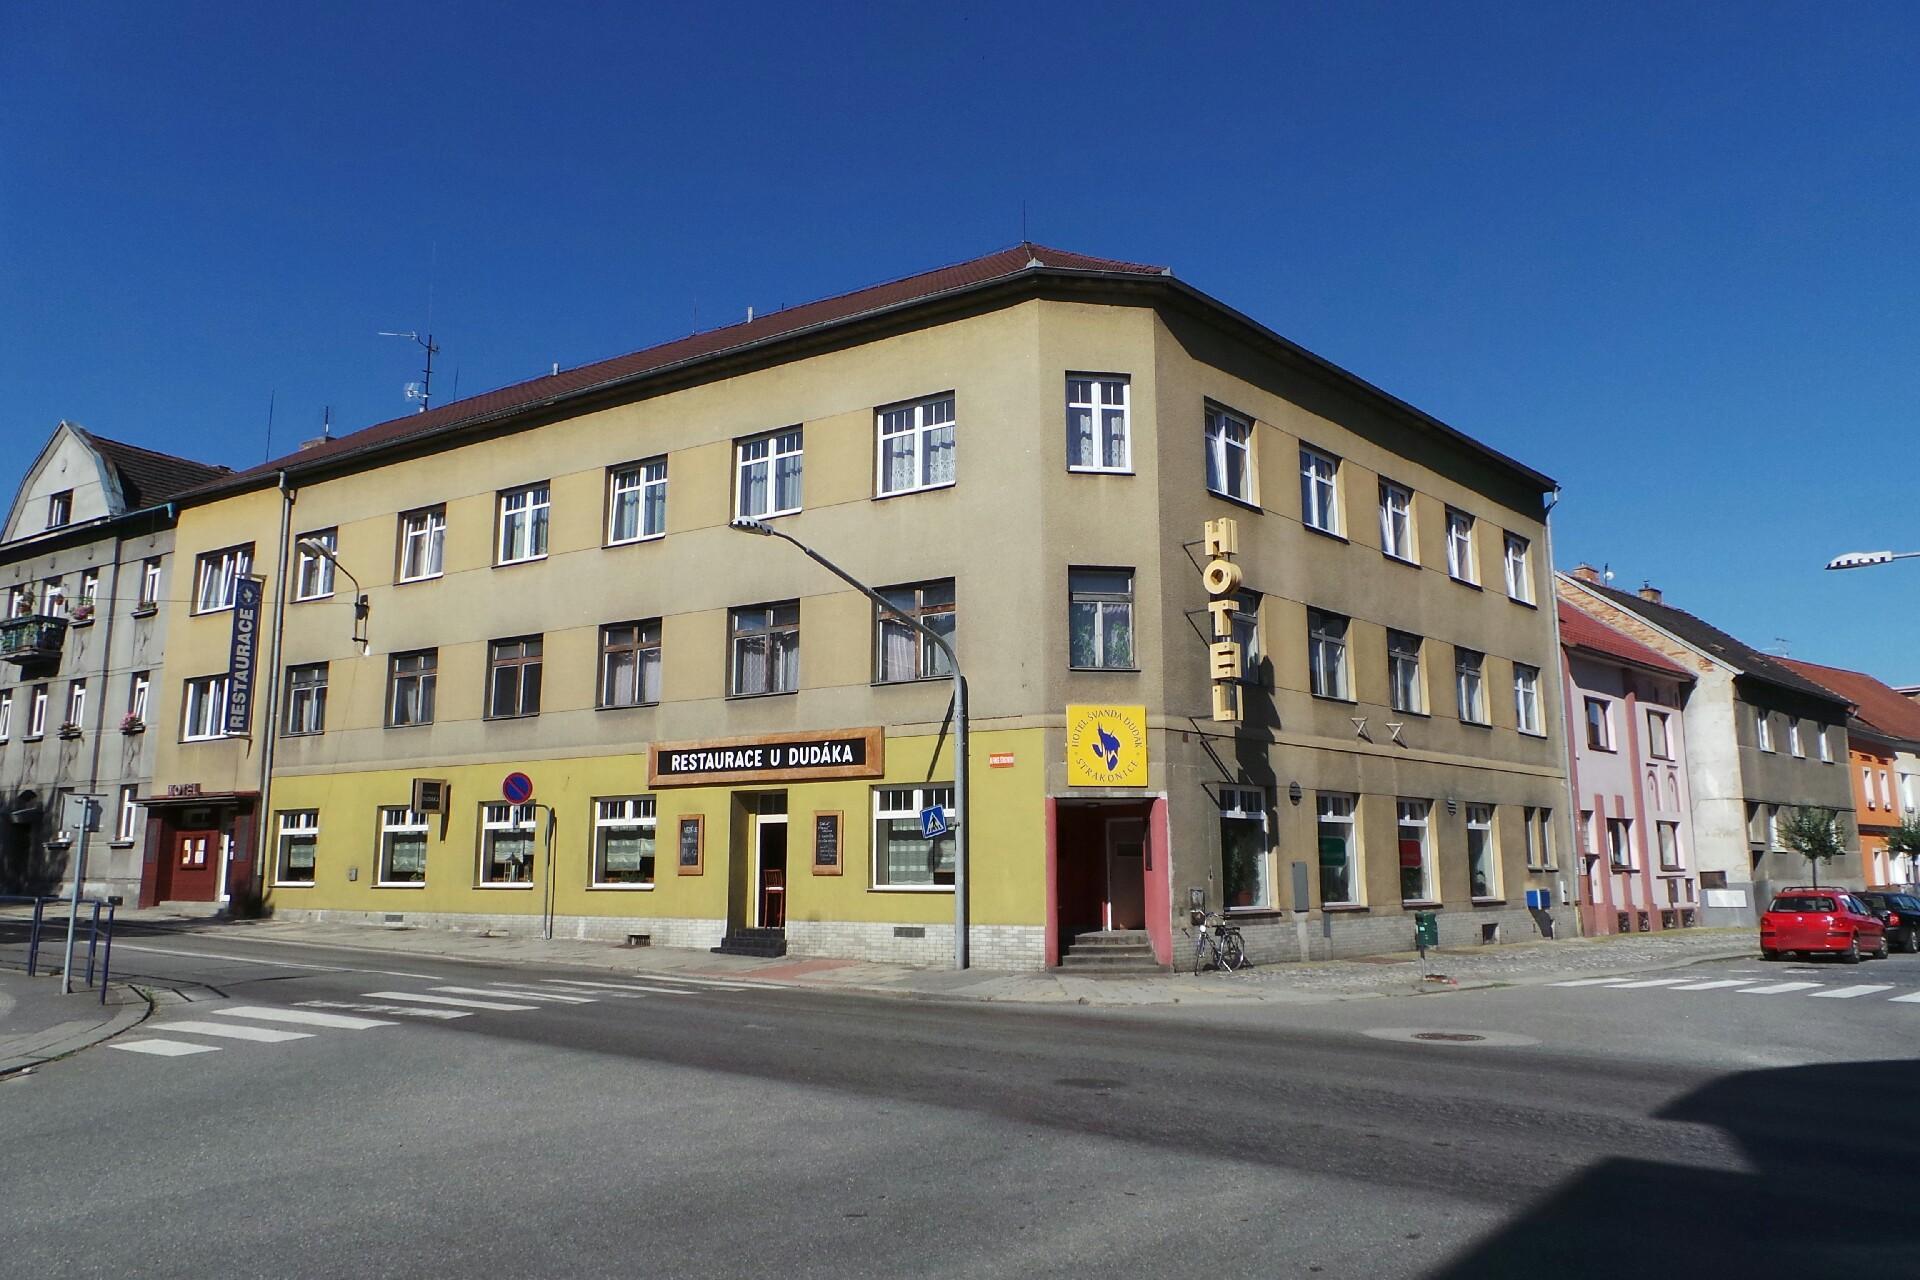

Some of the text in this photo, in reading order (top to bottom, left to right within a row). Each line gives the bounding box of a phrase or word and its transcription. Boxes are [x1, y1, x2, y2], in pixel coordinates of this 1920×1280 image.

[1203, 517, 1243, 721] HOTEL
[230, 608, 254, 728] RESTAURACE
[1072, 719, 1088, 748] HOTEL
[671, 742, 854, 772] RESTAURACE U DUDÁKA
[1076, 758, 1138, 783] STRAKONICE
